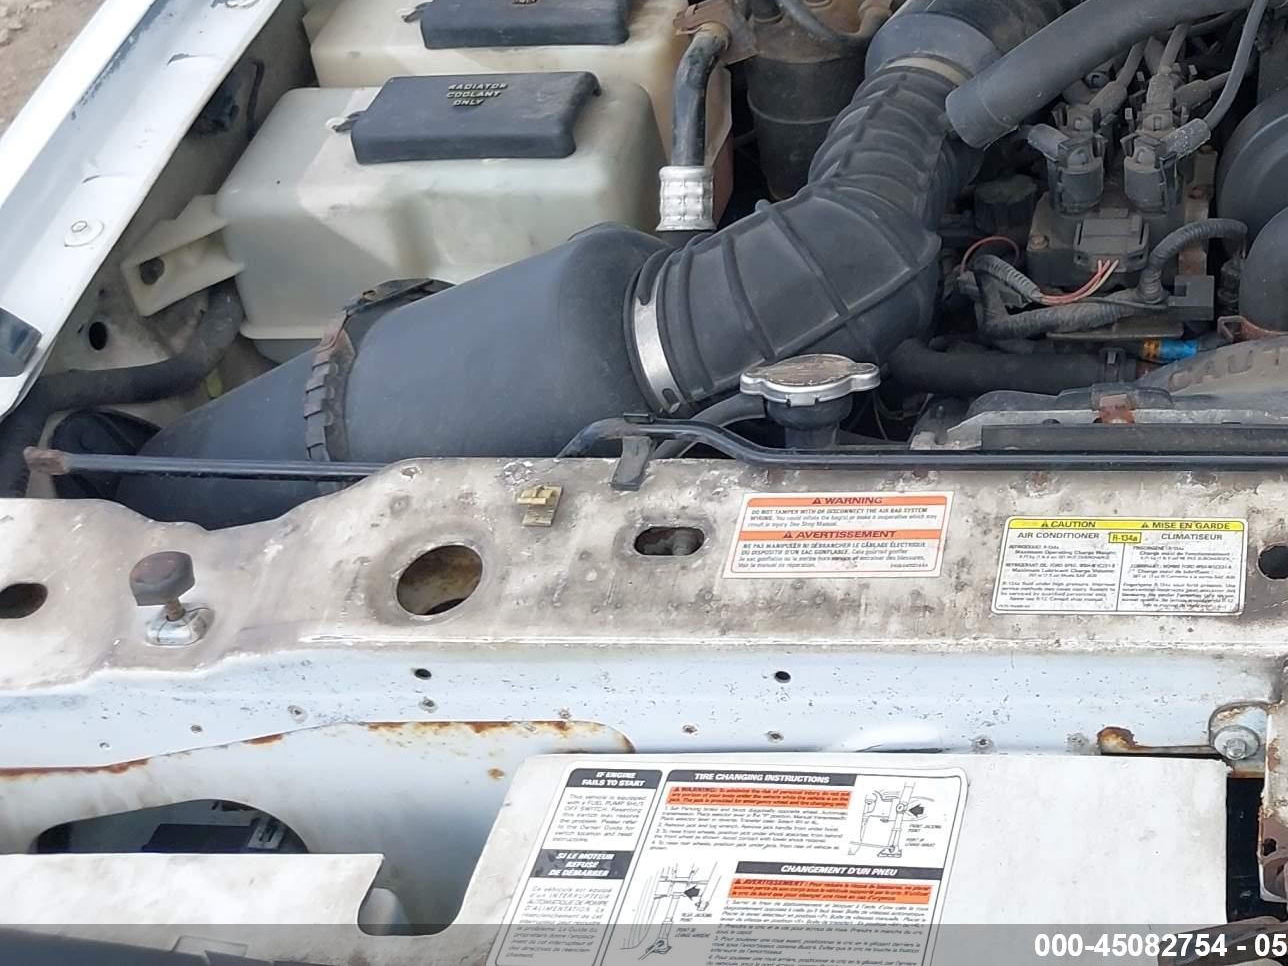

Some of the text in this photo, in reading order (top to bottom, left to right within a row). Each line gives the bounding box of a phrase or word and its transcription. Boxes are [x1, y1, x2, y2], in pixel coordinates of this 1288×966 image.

[448, 82, 509, 91] RADIATOR
[446, 90, 502, 98] COOLANT
[795, 530, 897, 538] AVERTISSEMENT
[1112, 534, 1138, 542] R-134a
[715, 773, 763, 781] CHANGING
[764, 774, 830, 783] INSTRUCTIONS
[563, 869, 610, 877] DÉMARRER
[781, 865, 897, 876] CHANGEMENT D'UN PNEU
